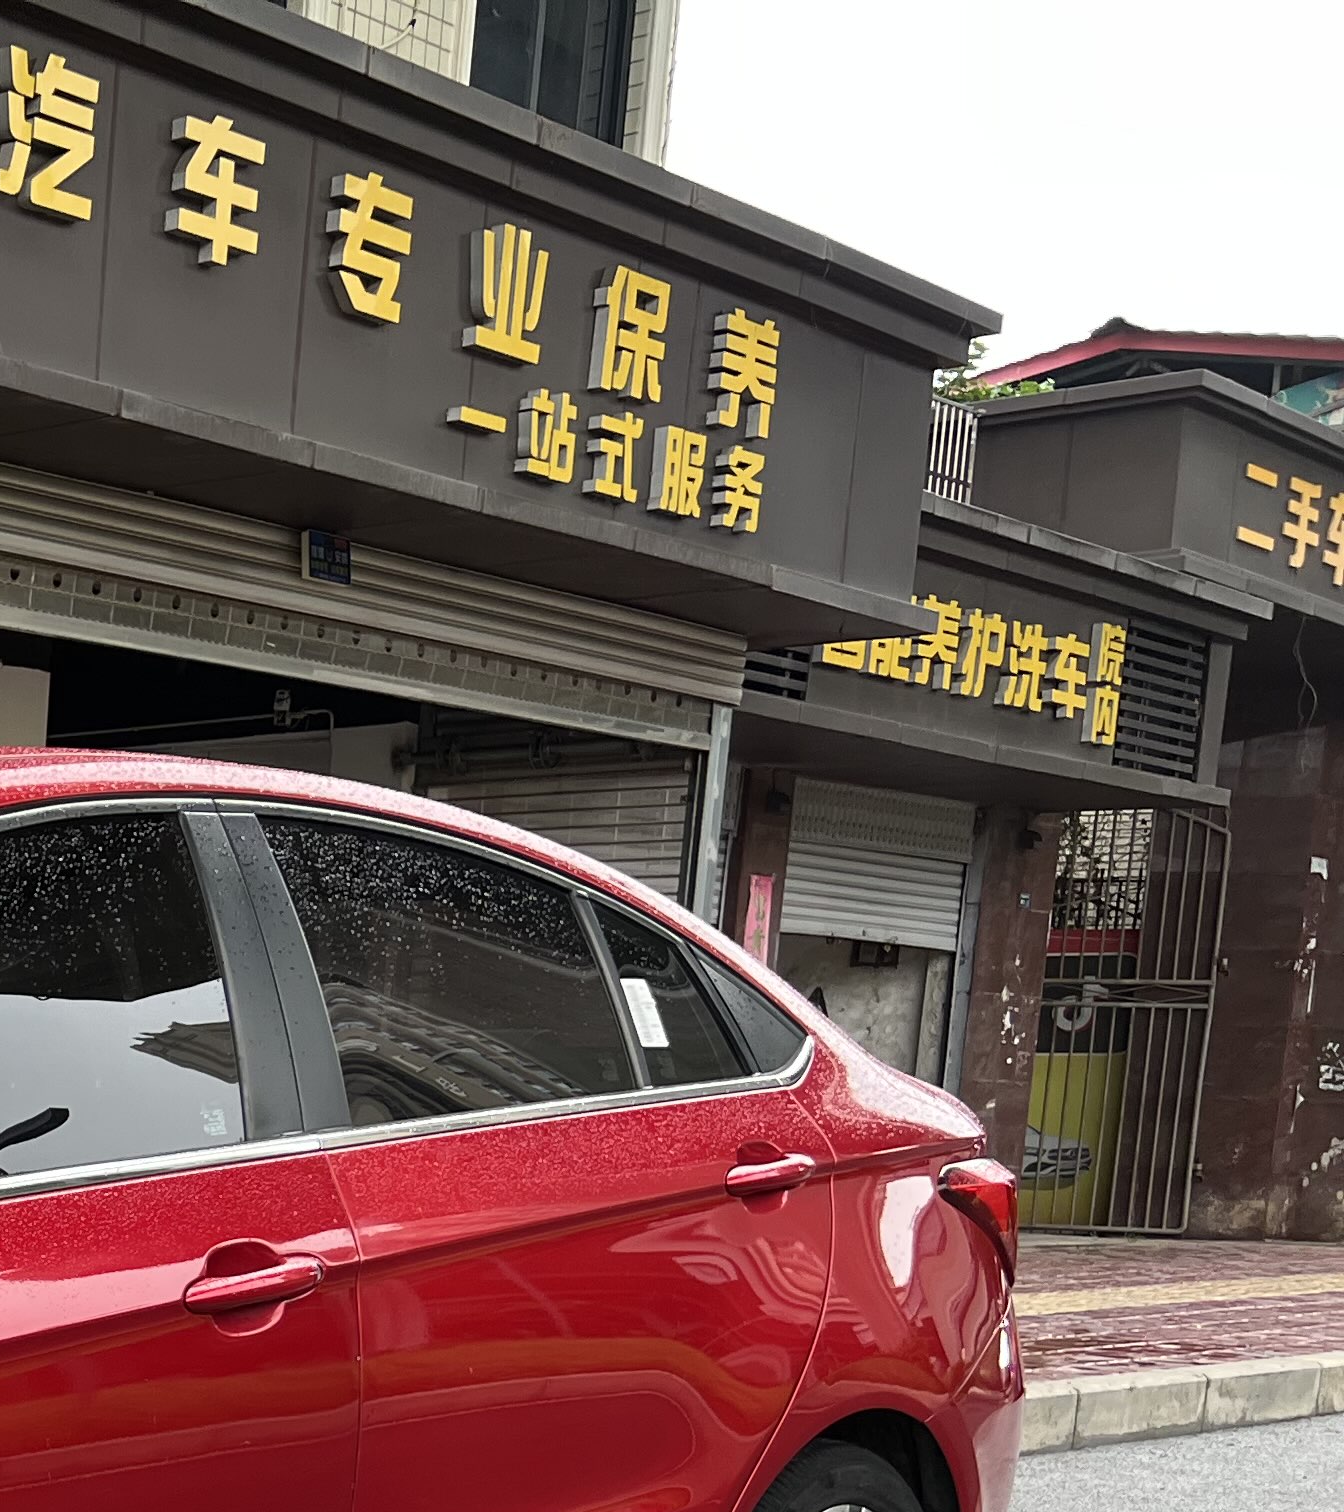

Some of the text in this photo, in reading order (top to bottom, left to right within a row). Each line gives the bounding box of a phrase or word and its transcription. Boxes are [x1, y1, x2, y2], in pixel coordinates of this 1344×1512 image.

[446, 388, 767, 535] 一站式服务
